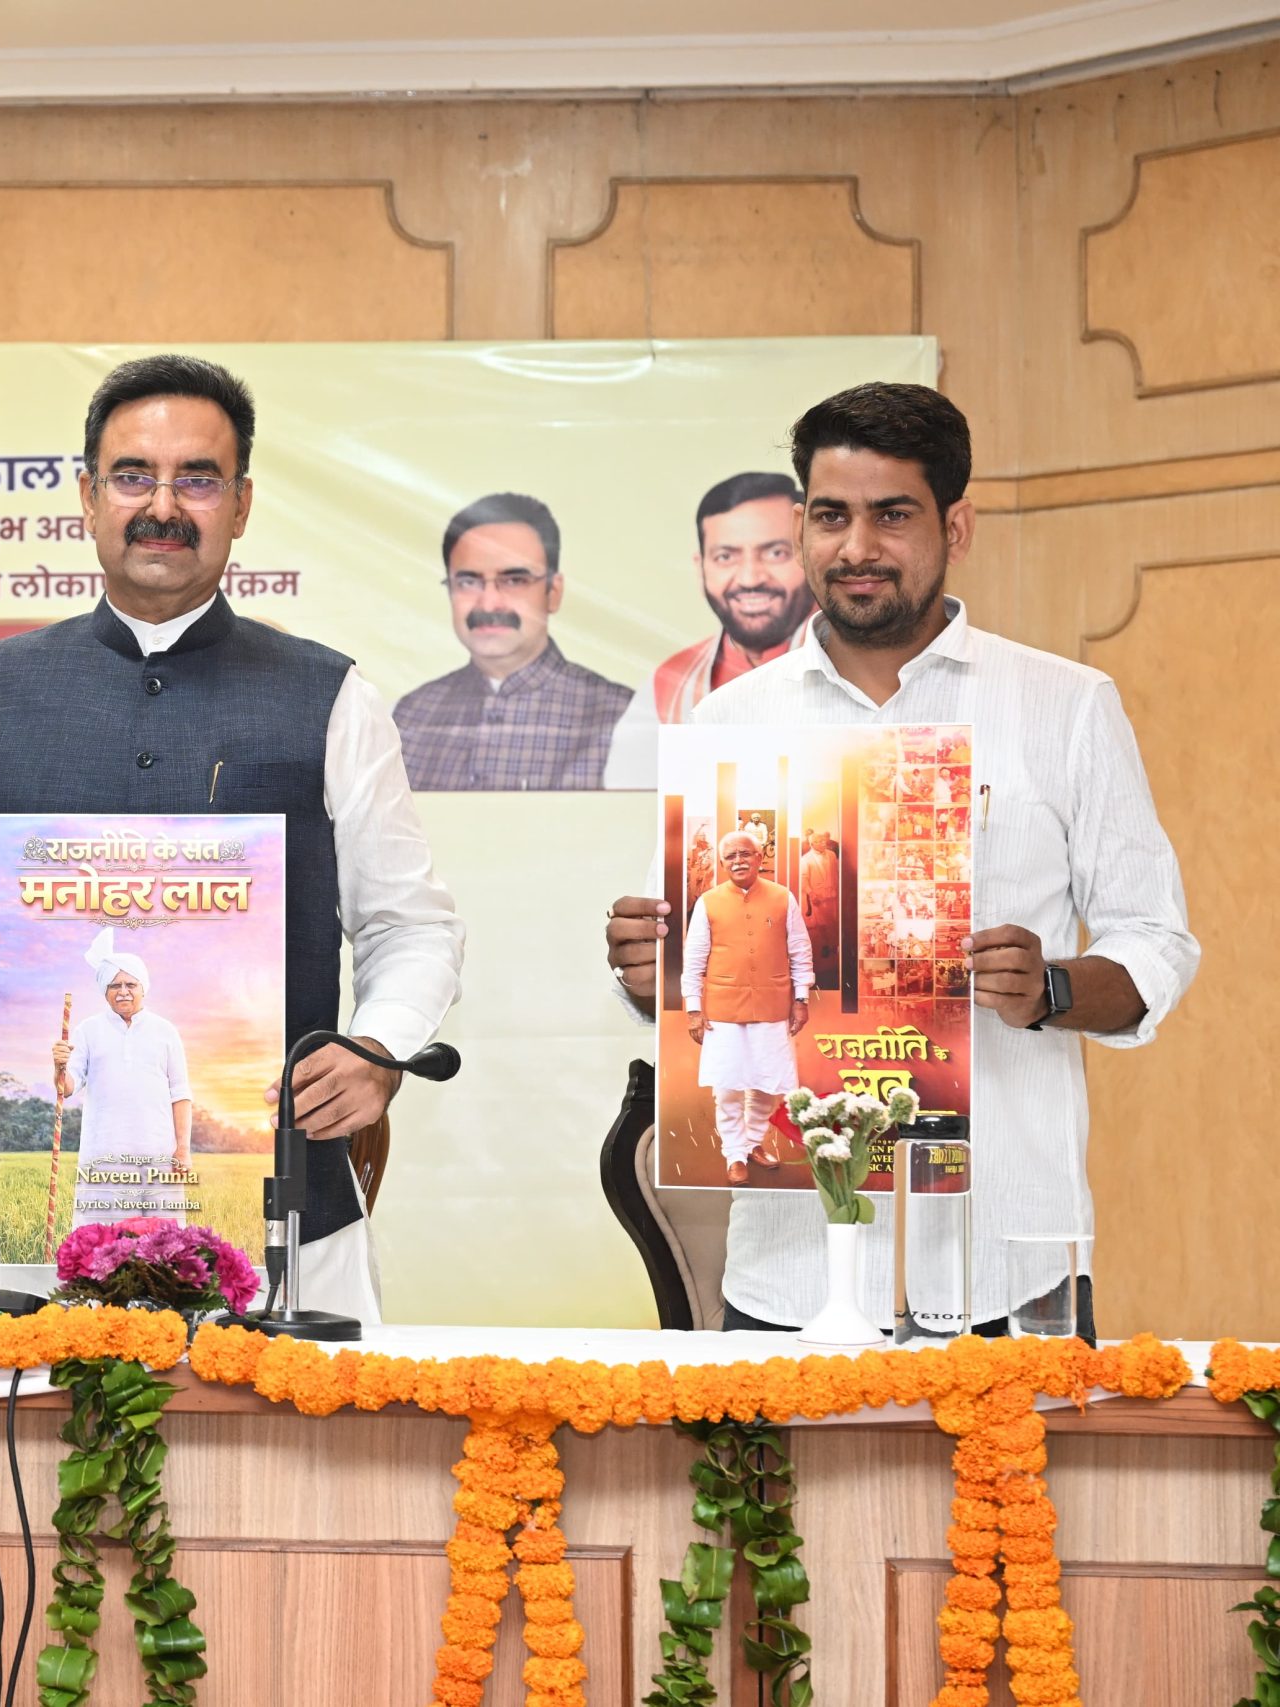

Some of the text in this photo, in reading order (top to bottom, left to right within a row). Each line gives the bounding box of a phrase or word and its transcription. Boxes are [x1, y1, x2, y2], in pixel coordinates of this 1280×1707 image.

[36, 516, 95, 542] अव
[46, 829, 222, 862] राजनीति के संत
[19, 863, 252, 916] मनोहर लाल
[813, 1025, 928, 1060] राजनीति
[120, 1154, 152, 1165] Singer
[871, 1154, 893, 1162] AVEE
[75, 1167, 199, 1184] Naveen Punia
[73, 1198, 200, 1211] Lyrics Naveen Lamba
